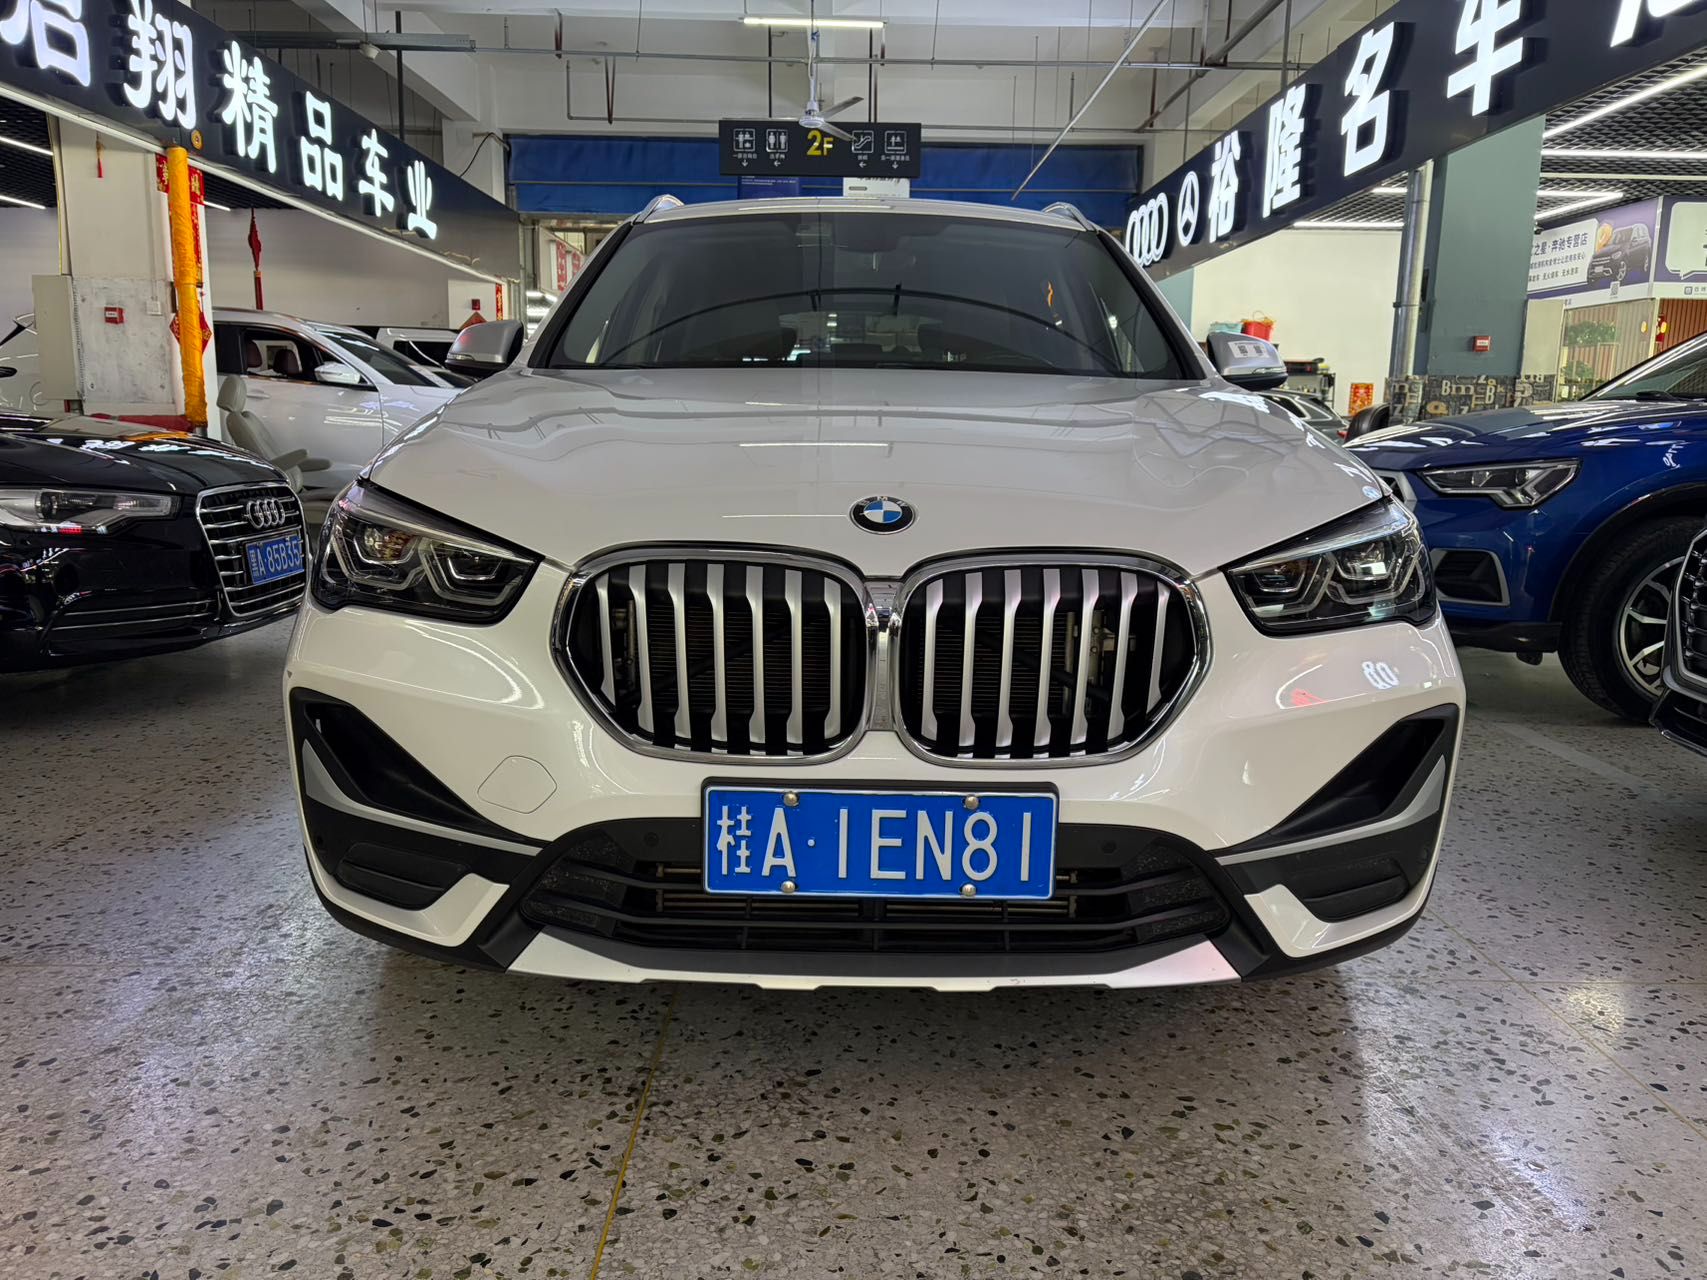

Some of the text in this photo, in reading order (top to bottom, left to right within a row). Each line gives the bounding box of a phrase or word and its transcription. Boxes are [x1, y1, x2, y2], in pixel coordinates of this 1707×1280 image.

[806, 129, 834, 156] 2F
[1209, 0, 1700, 243] 裕隆名车
[1531, 232, 1588, 256] 之星·奔驰专营店
[716, 805, 1032, 882] 桂A·1EN81
